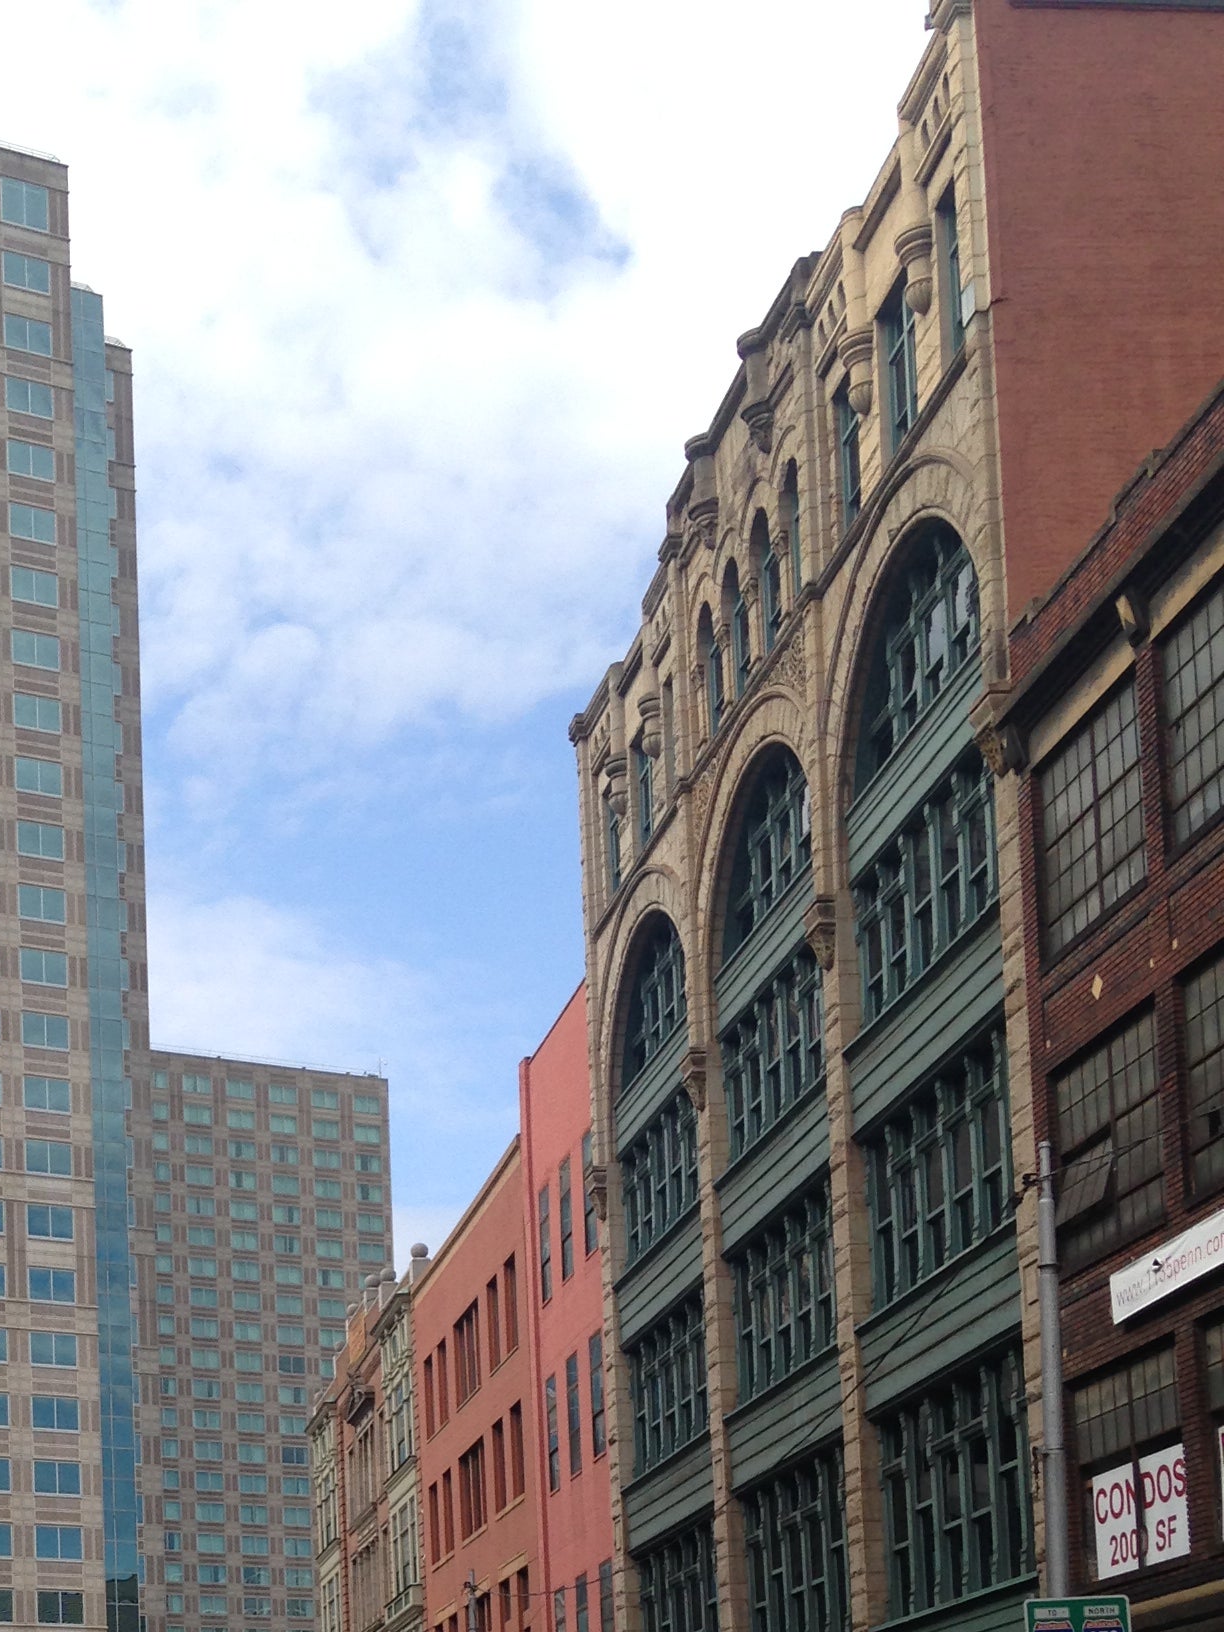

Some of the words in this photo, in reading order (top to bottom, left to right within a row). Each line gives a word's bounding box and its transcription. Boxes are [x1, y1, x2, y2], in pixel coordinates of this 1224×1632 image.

[1095, 1458, 1187, 1525] CONDOS
[1109, 1525, 1149, 1567] 2000
[1156, 1515, 1177, 1551] SF
[1088, 1607, 1115, 1615] NORTH
